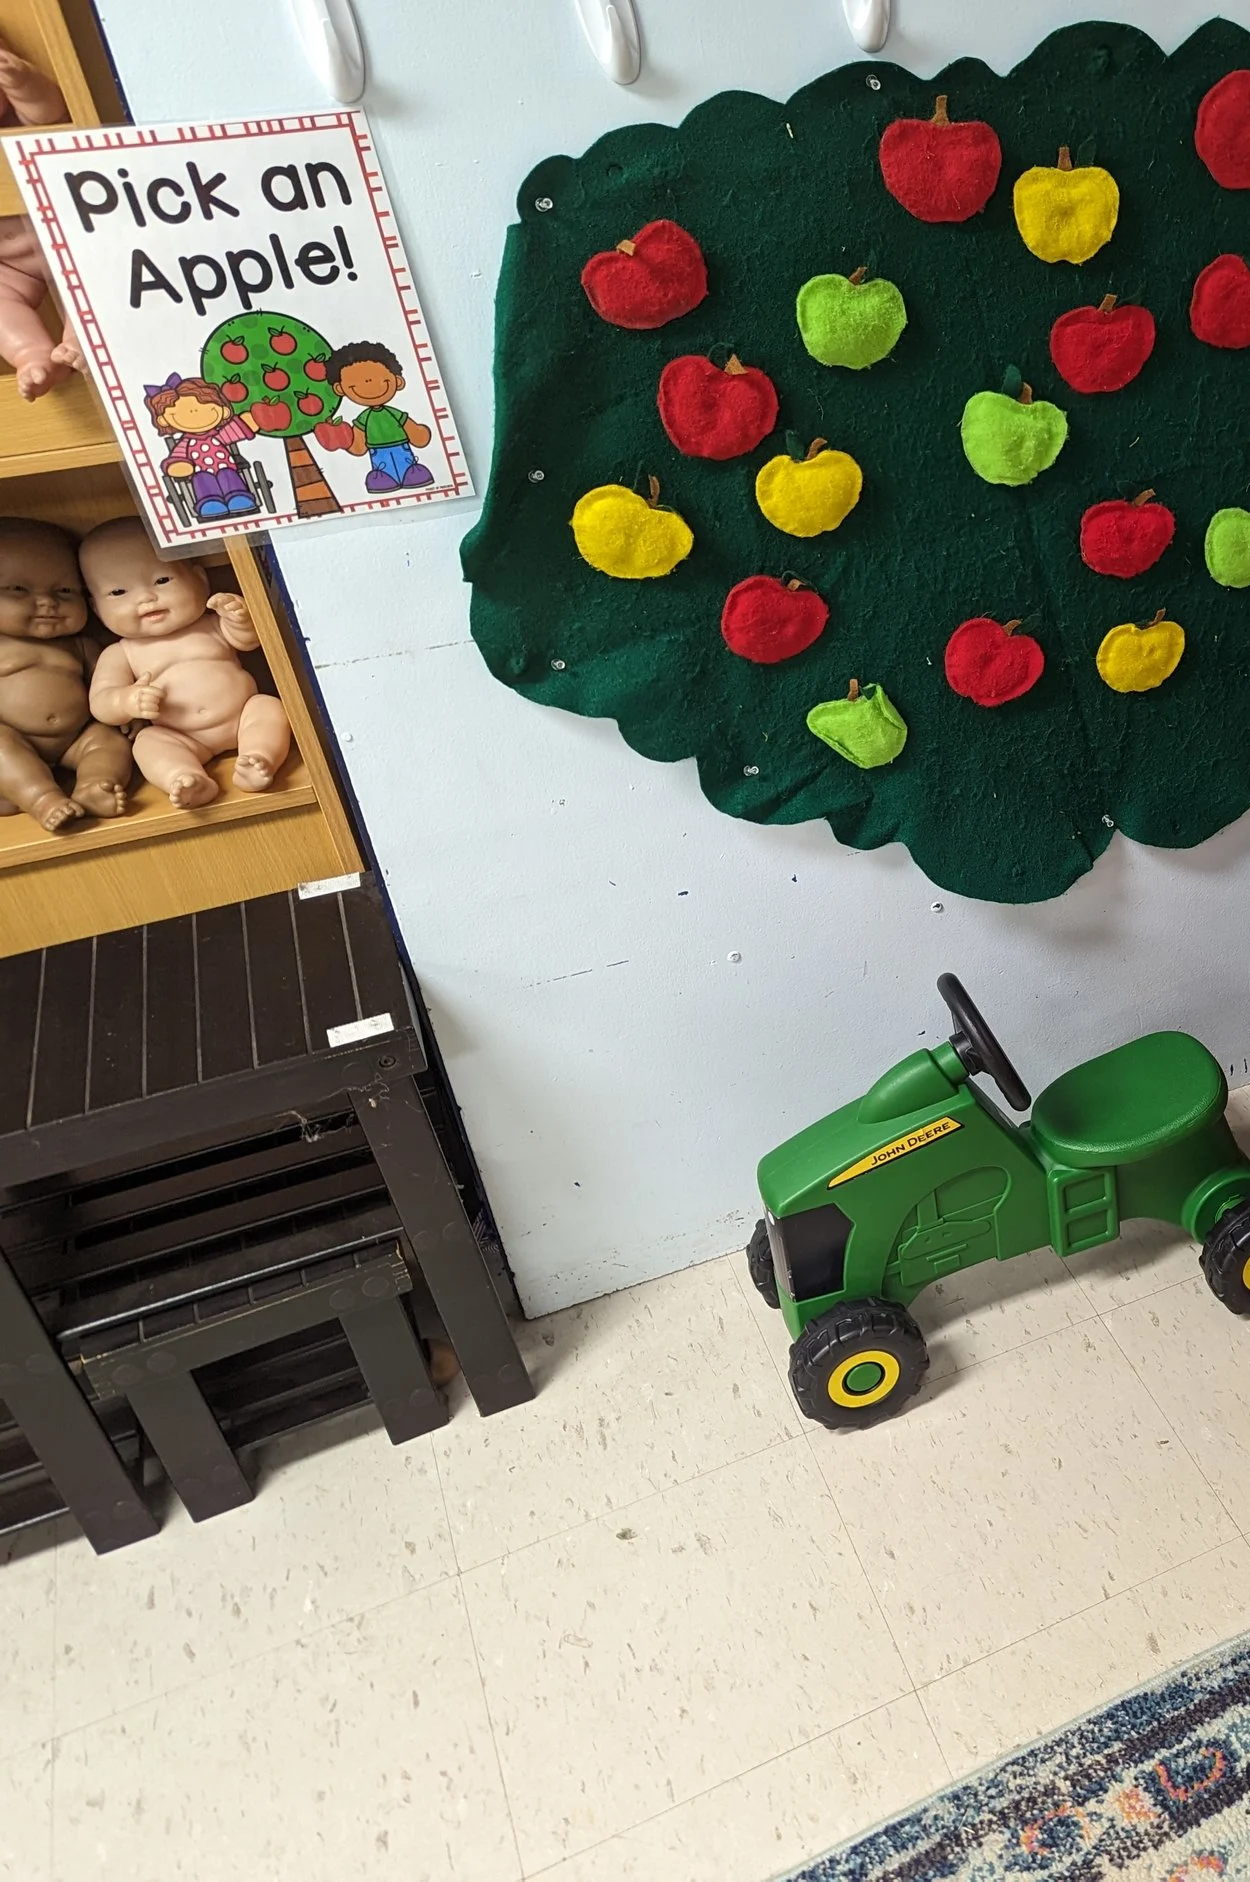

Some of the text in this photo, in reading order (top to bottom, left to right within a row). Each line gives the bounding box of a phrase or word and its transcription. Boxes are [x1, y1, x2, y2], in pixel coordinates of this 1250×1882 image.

[64, 161, 353, 233] Pick an
[130, 225, 358, 316] Apple!
[871, 1121, 951, 1166] JOHN DEERE
